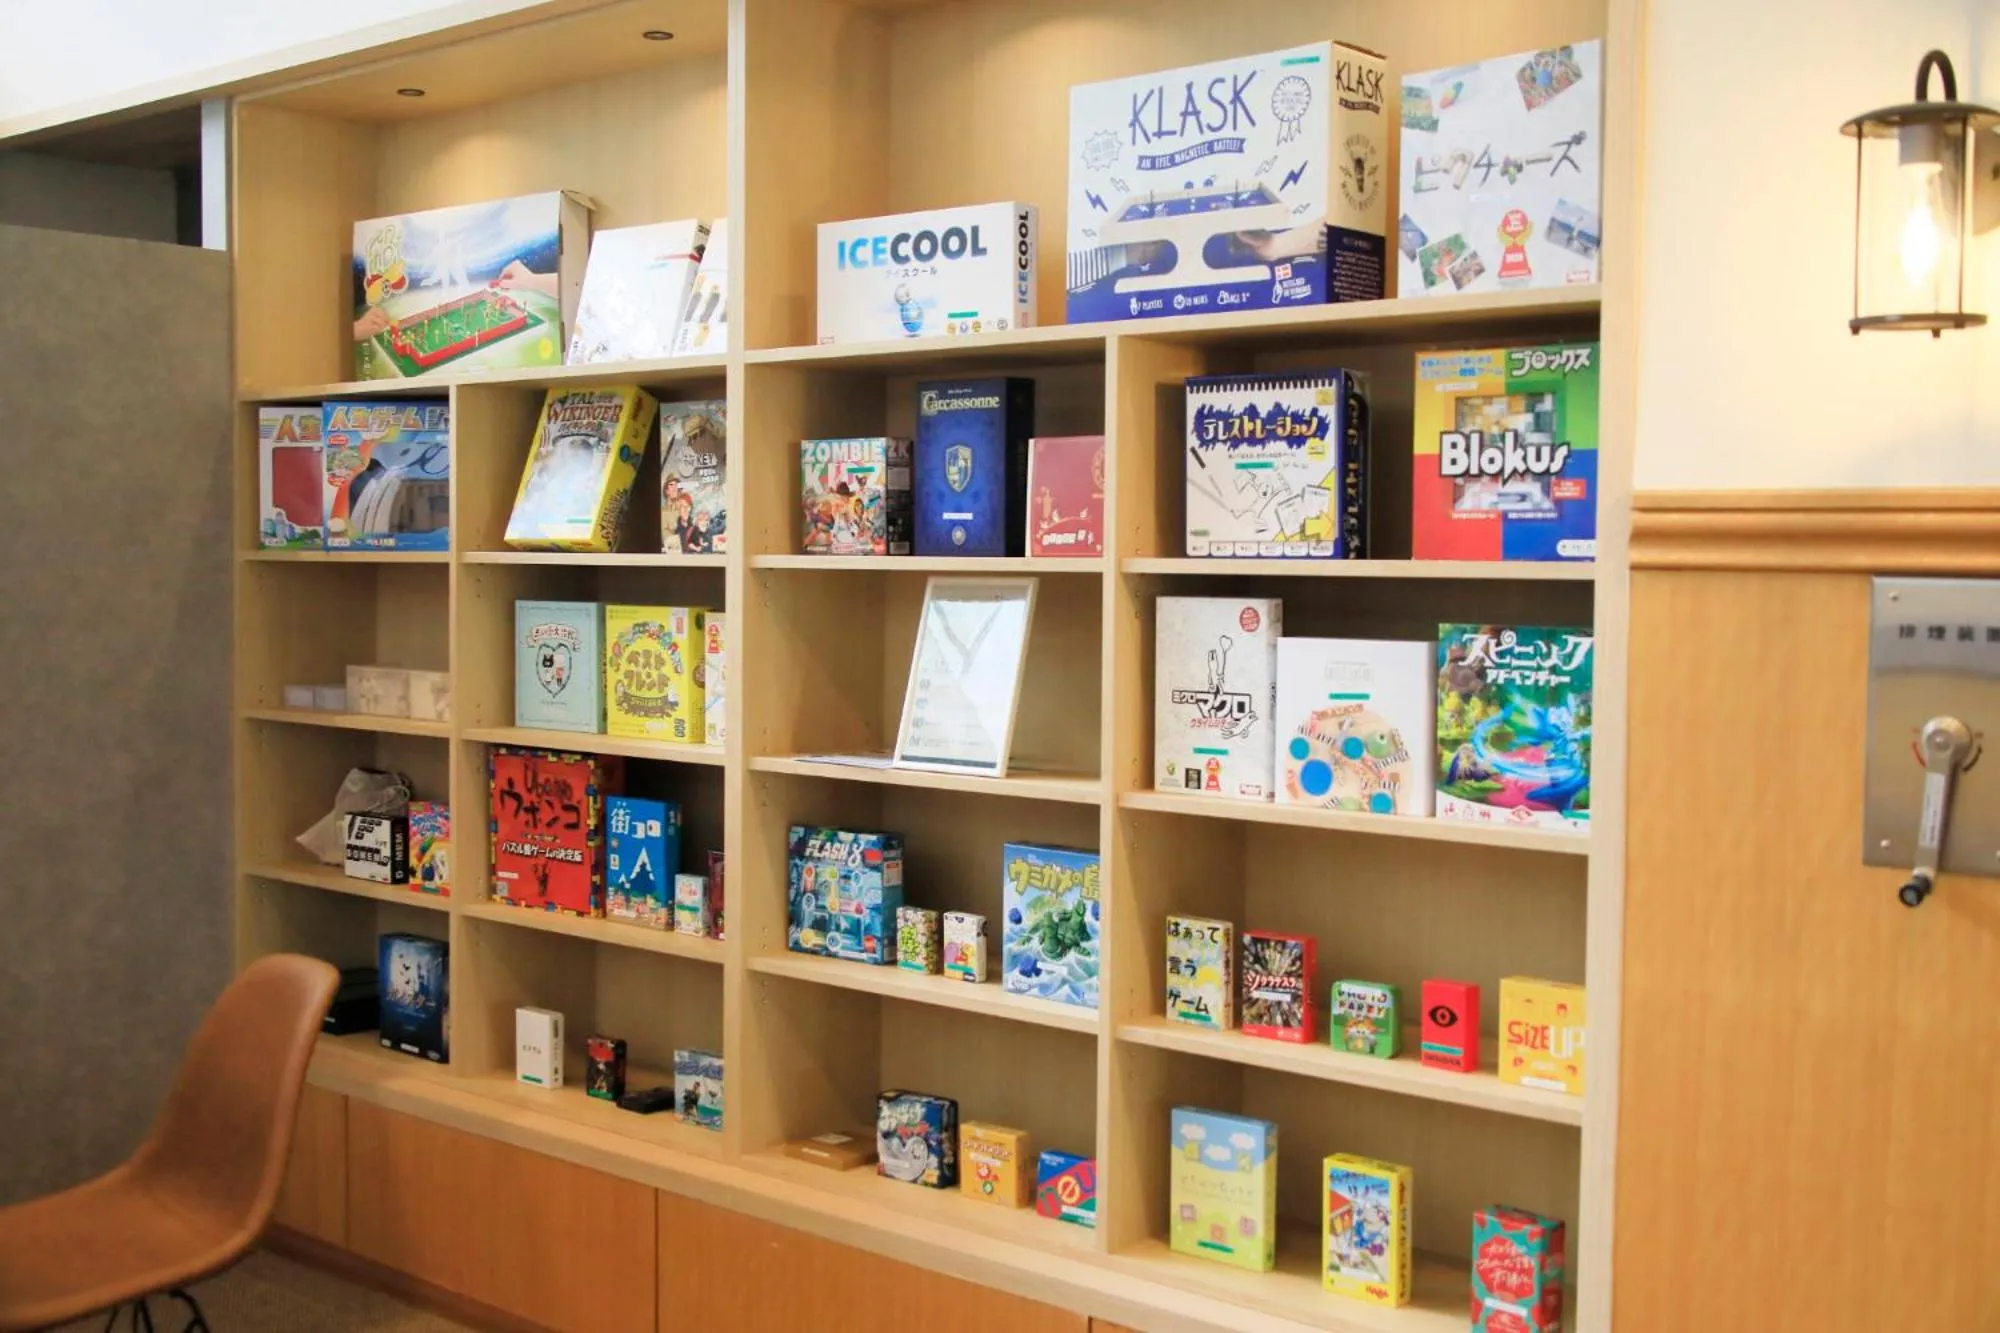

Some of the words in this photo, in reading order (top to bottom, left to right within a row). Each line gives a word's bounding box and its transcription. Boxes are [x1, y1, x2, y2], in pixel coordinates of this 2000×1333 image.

[1335, 60, 1384, 104] KLASK
[1128, 69, 1258, 147] KLASK
[1413, 129, 1587, 195] ピクチャーズ
[837, 224, 988, 271] ICECOOL
[1017, 210, 1029, 304] ICECOOL
[1511, 347, 1592, 377] ブロックス
[328, 405, 423, 431] 人生ゲーム
[921, 390, 1000, 416] Carcassonne
[1203, 415, 1320, 440] テレストレーション
[802, 440, 885, 463] ZOMBIE
[1440, 431, 1570, 487] Blokus
[1485, 668, 1572, 686] アドベンチャー
[1171, 689, 1197, 705] ミクロ
[1196, 691, 1252, 720] マクロ
[499, 776, 581, 830] ウボンゴ
[610, 808, 662, 839] 街コロ
[804, 838, 848, 860] FLASH
[1008, 858, 1100, 900] ウミガメの島
[1168, 955, 1198, 978] 言う
[1168, 987, 1209, 1015] ゲーム
[1549, 1025, 1586, 1059] UP
